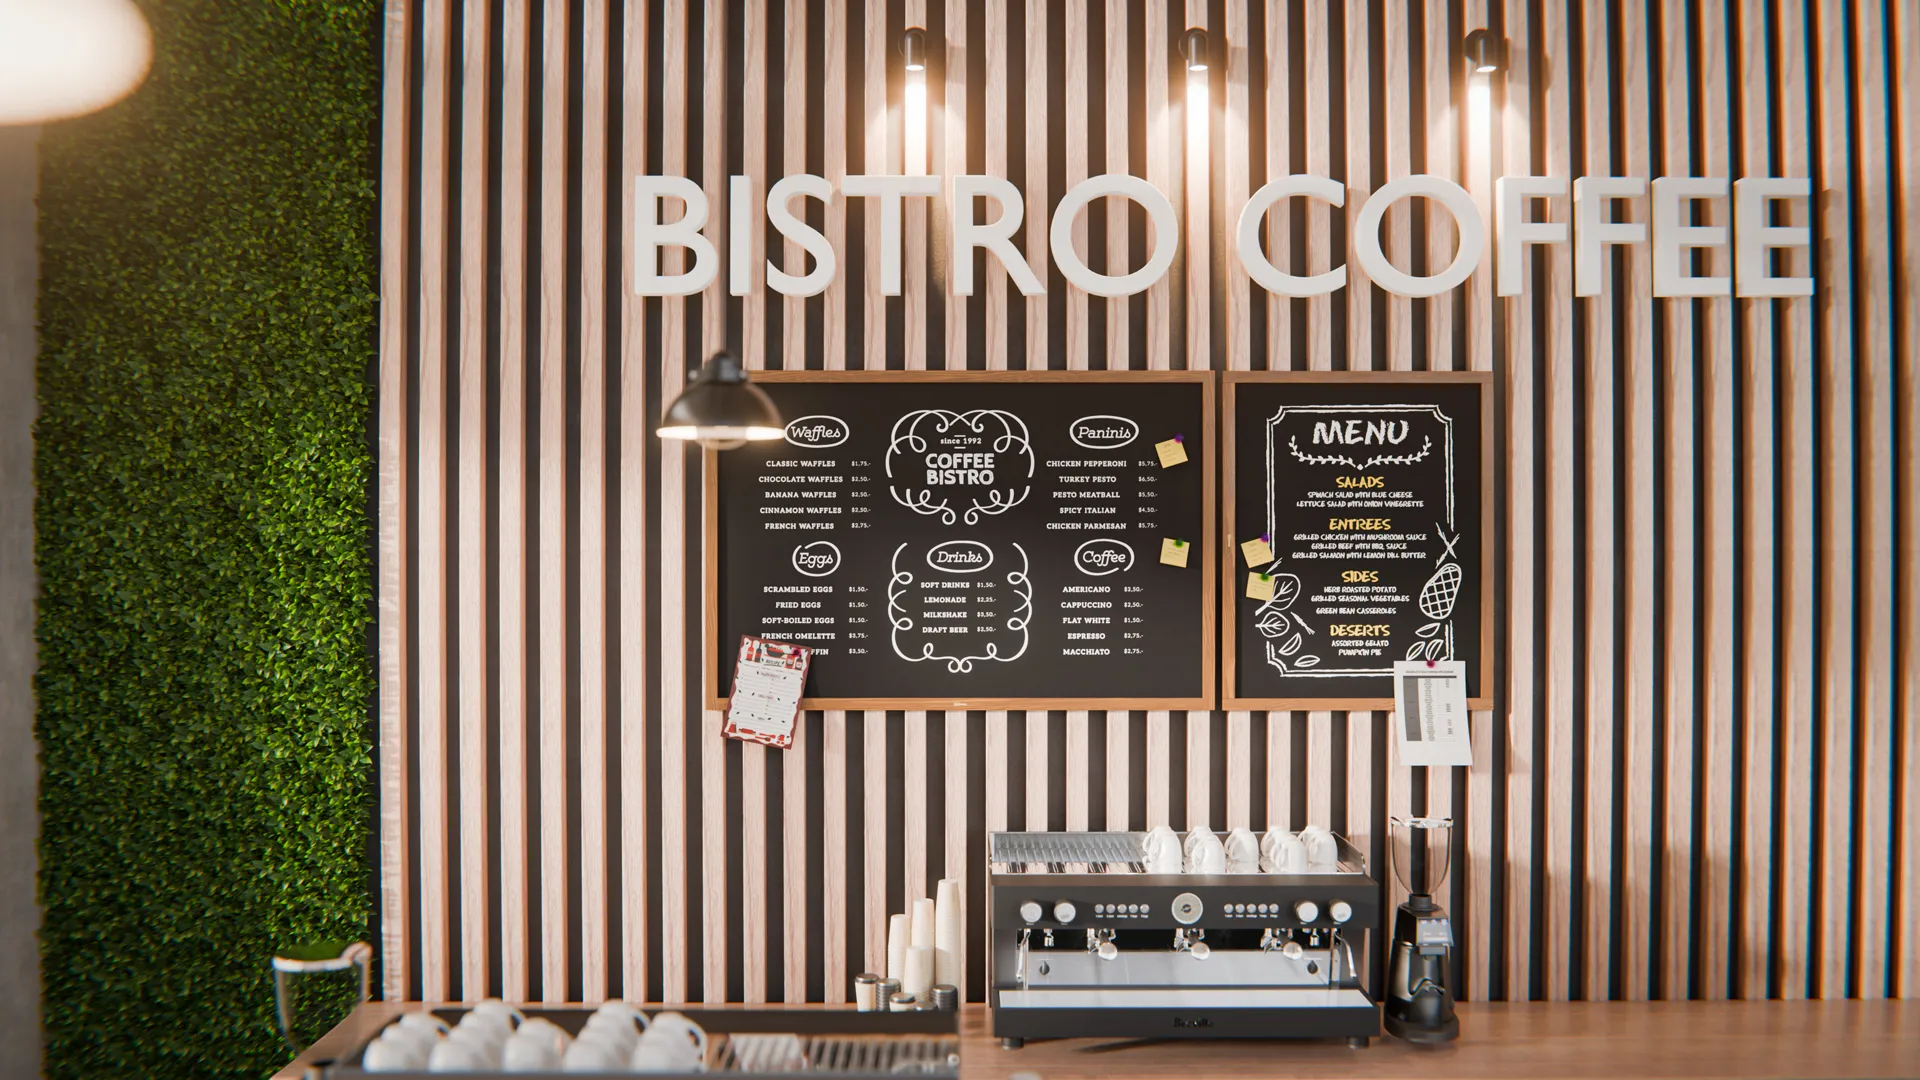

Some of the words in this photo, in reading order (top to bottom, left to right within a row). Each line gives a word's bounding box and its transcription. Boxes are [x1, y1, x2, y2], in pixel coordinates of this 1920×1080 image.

[634, 173, 1180, 298] BISTRO
[1236, 174, 1815, 298] COFFEE
[790, 424, 842, 441] Waffles
[1077, 426, 1132, 440] Paninis
[1312, 418, 1410, 446] MENU
[940, 437, 961, 445] since
[962, 437, 982, 445] 1992
[765, 460, 798, 468] CLASSIC
[799, 460, 836, 468] WAFFLES
[925, 452, 995, 469] COFFEE
[1045, 460, 1082, 468] CHICKEN
[1083, 460, 1127, 468] PEPPERONI
[758, 475, 806, 483] CHOCOLATE
[807, 475, 844, 483] WAFFLES
[926, 469, 995, 486] BISTRO
[1058, 475, 1091, 483] TURKEY
[1092, 475, 1117, 483] PESTO
[1335, 475, 1385, 489] SALADS
[764, 491, 800, 499] BANANA
[800, 491, 837, 499] WAFFLES
[1052, 491, 1078, 499] PESTO
[1079, 491, 1121, 499] MEATBALL
[1334, 491, 1355, 499] SALAD
[1371, 491, 1388, 499] BLUE
[1388, 491, 1414, 499] CHEESE
[1296, 500, 1326, 508] LETTUCE
[1326, 500, 1347, 508] SALAD
[1363, 500, 1384, 508] ONION
[759, 506, 805, 514] CINNAMON
[805, 506, 842, 514] WAFFLES
[1059, 506, 1083, 514] SPICY
[1084, 506, 1117, 514] ITALIAN
[764, 522, 797, 530] FRENCH
[798, 522, 835, 530] WAFFLES
[1046, 522, 1082, 530] CHICKEN
[1083, 522, 1127, 530] PARMESAN
[1328, 518, 1392, 531] ENTREES
[1293, 533, 1320, 541] GRILLED
[1320, 533, 1349, 541] CHICKEN
[1366, 533, 1405, 541] MUSHROOM
[1405, 533, 1427, 541] SAUCE
[1310, 542, 1338, 550] GRILLED
[1337, 542, 1354, 550] BEEF
[1385, 542, 1408, 550] SAUCE
[936, 550, 983, 563] Drinks
[1082, 549, 1126, 567] Coffee
[1291, 551, 1319, 559] GRILLED
[1318, 551, 1346, 559] SALMON
[1362, 551, 1386, 559] LEMON
[1386, 551, 1400, 559] DILL
[1400, 551, 1427, 559] BUTTER
[797, 551, 834, 569] Eggs
[1341, 569, 1379, 583] SIDES
[763, 585, 811, 593] SCRAMBLED
[812, 585, 834, 593] EGGS
[920, 581, 940, 589] SOFT
[941, 581, 971, 589] DRINKS
[1061, 585, 1111, 593] AMERICANO
[1323, 585, 1341, 594] HERB
[1341, 585, 1371, 594] ROASTED
[1371, 585, 1397, 594] POTATO
[923, 596, 967, 604] LEMONADE
[1310, 594, 1337, 602] GRILLED
[1337, 594, 1370, 602] SEASONAL
[1369, 594, 1410, 602] VEGETABLES
[775, 601, 799, 609] FRIED
[800, 601, 822, 609] EGGS
[1060, 601, 1113, 609] CAPPUCCINO
[922, 611, 968, 619] MILKSHAKE
[1315, 607, 1339, 615] GREEN
[1338, 607, 1356, 615] BEAN
[1355, 607, 1397, 615] CASSEROLES
[761, 616, 813, 624] SOFT-BOILED
[814, 616, 835, 624] EGGS
[1062, 616, 1083, 624] FLAT
[1083, 616, 1111, 624] WHITE
[921, 626, 948, 634] DRAFT
[948, 626, 969, 634] BEER
[1329, 623, 1391, 637] DESERTS
[761, 632, 793, 640] FRENCH
[794, 632, 836, 640] OMELETTE
[1067, 632, 1106, 640] ESPRESSO
[1331, 639, 1365, 647] ASSORTED
[1364, 639, 1390, 647] GELATO
[810, 648, 830, 656] FFIN
[1062, 648, 1111, 656] MACCHIATO
[1338, 648, 1370, 656] PUMPKIN
[1370, 648, 1382, 656] PIE
